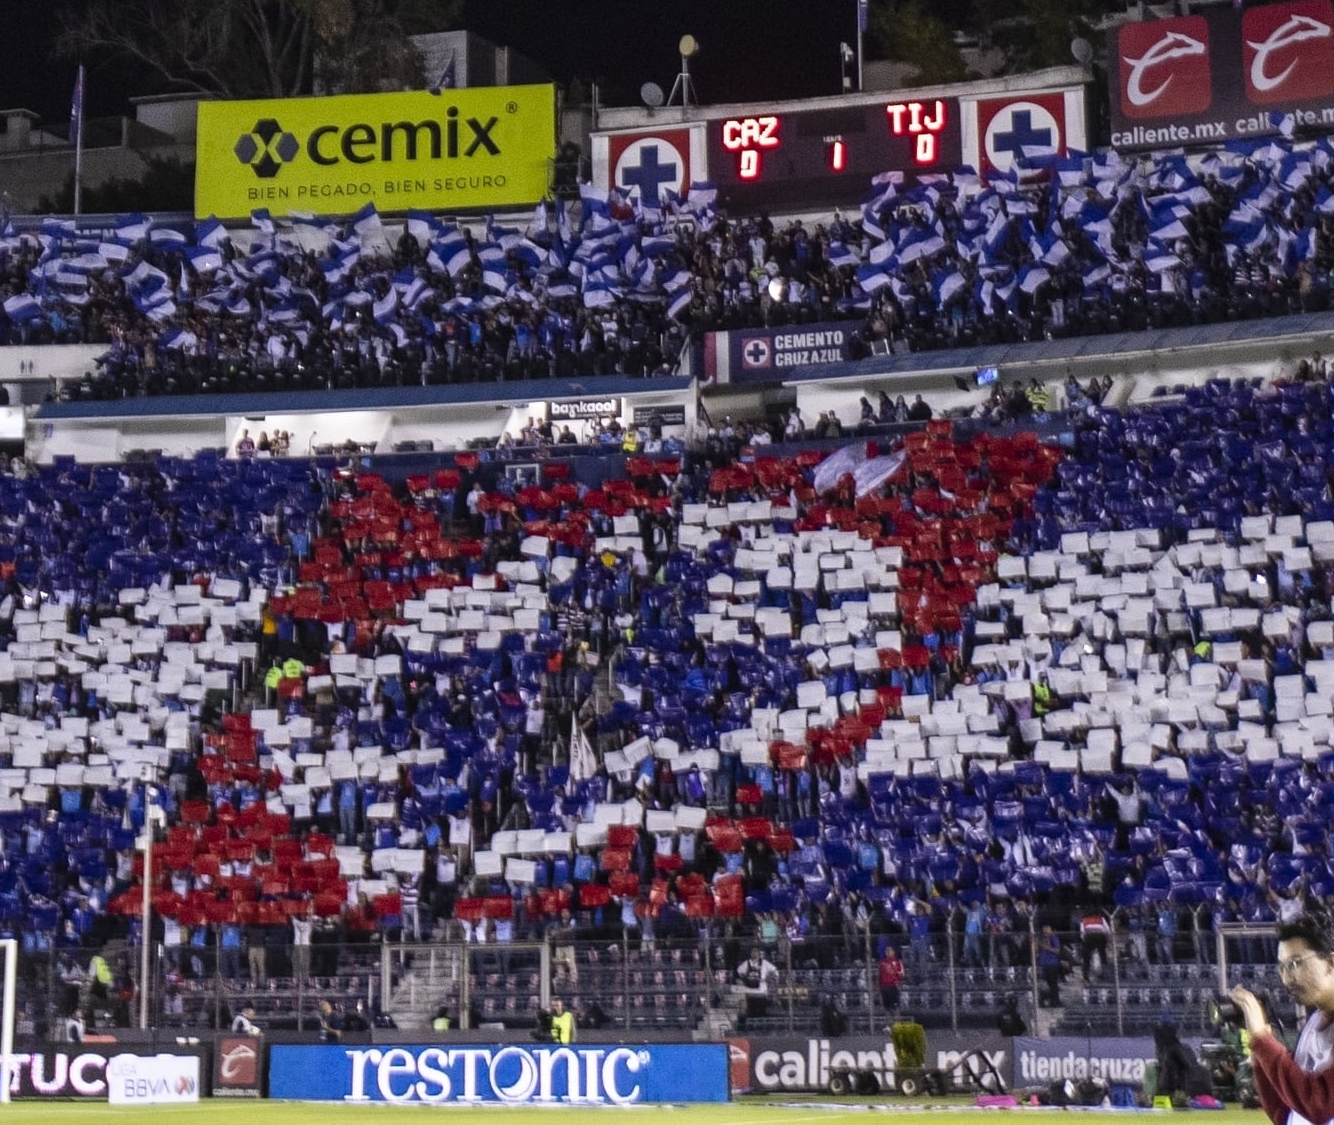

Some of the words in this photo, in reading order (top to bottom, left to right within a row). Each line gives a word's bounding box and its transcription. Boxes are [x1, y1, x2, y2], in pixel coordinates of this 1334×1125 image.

[886, 100, 945, 133] TIJ
[306, 105, 501, 166] cemix
[723, 117, 779, 149] CAZ
[1111, 121, 1227, 147] caliente.mx
[247, 186, 290, 200] BIEN
[297, 182, 376, 197] PEGADO,
[384, 179, 427, 193] BIEN
[433, 174, 507, 190] SEGURO
[774, 330, 844, 350] CEMENTO
[774, 351, 809, 367] CRUZ
[810, 348, 844, 363] AZUL
[124, 1078, 171, 1098] BBVA
